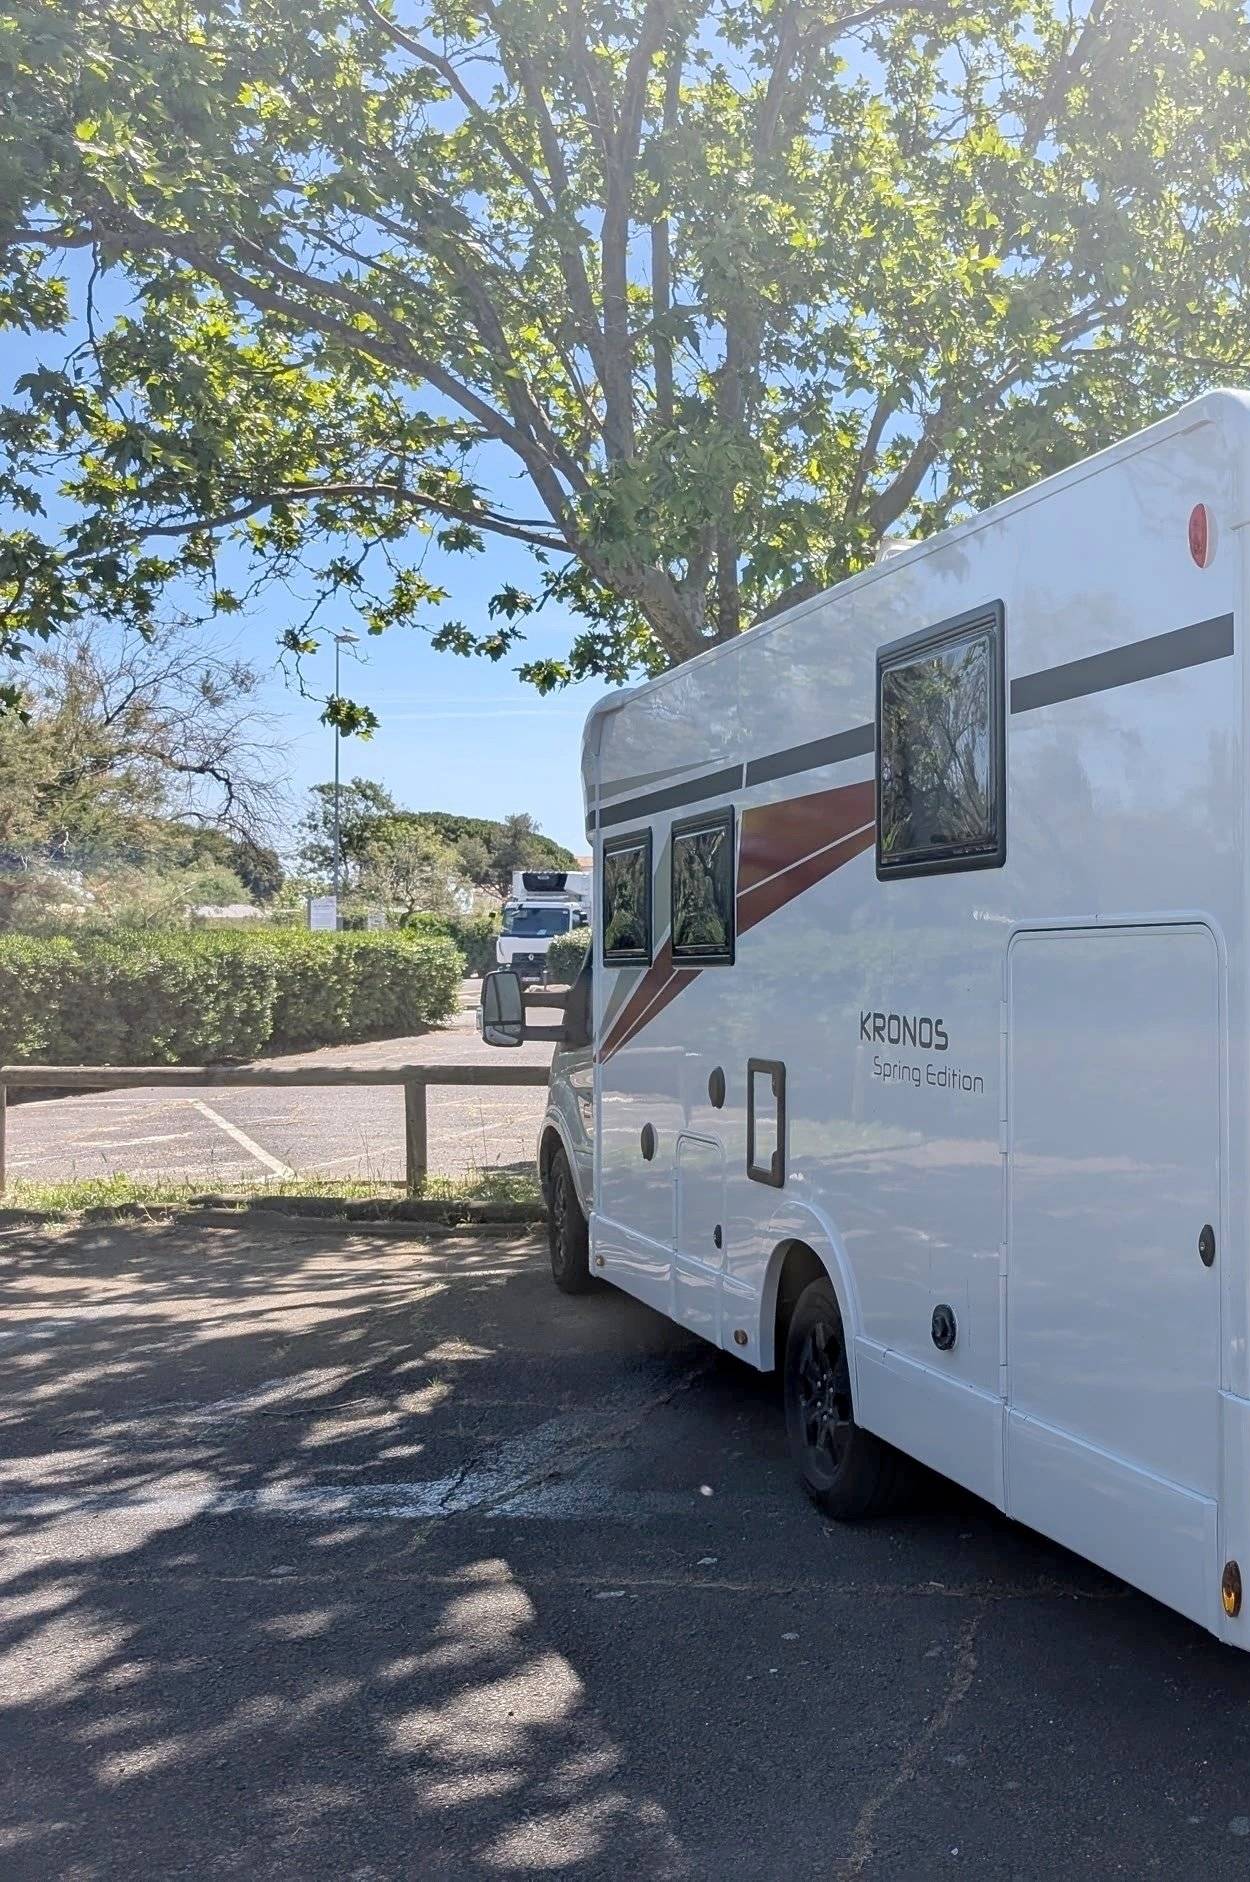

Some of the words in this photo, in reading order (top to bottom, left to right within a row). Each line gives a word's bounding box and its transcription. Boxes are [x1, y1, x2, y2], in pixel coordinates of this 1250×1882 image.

[860, 1010, 949, 1051] KRONOS
[873, 1055, 922, 1088] Spring
[926, 1063, 985, 1095] Edition
